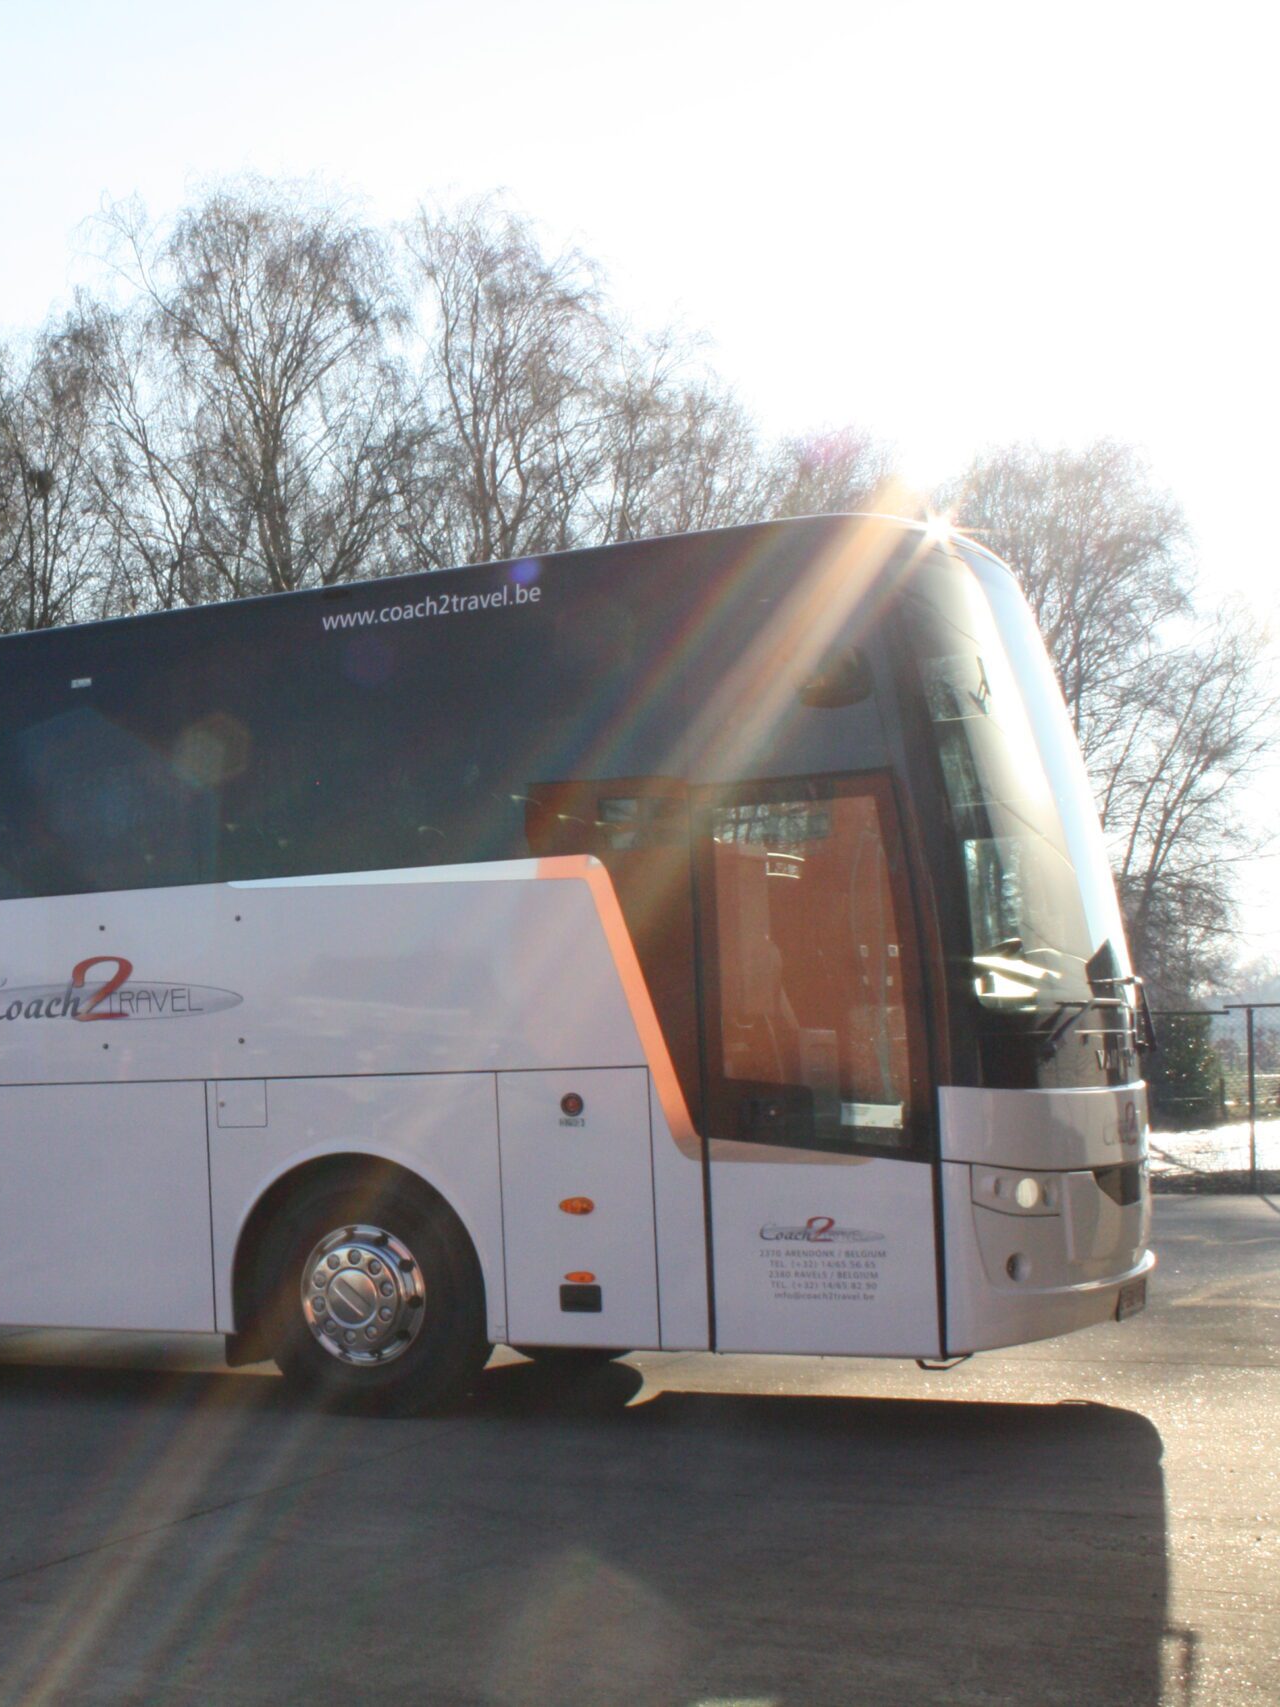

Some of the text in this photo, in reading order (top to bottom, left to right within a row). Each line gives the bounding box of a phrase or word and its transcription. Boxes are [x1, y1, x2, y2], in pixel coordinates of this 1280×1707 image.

[322, 584, 541, 631] www.coach2travel.be
[72, 955, 133, 1022] 2
[107, 988, 203, 1016] TRAVEL
[760, 1223, 810, 1241] Coach
[807, 1216, 835, 1243] 2
[845, 1250, 887, 1258] BELGIUM
